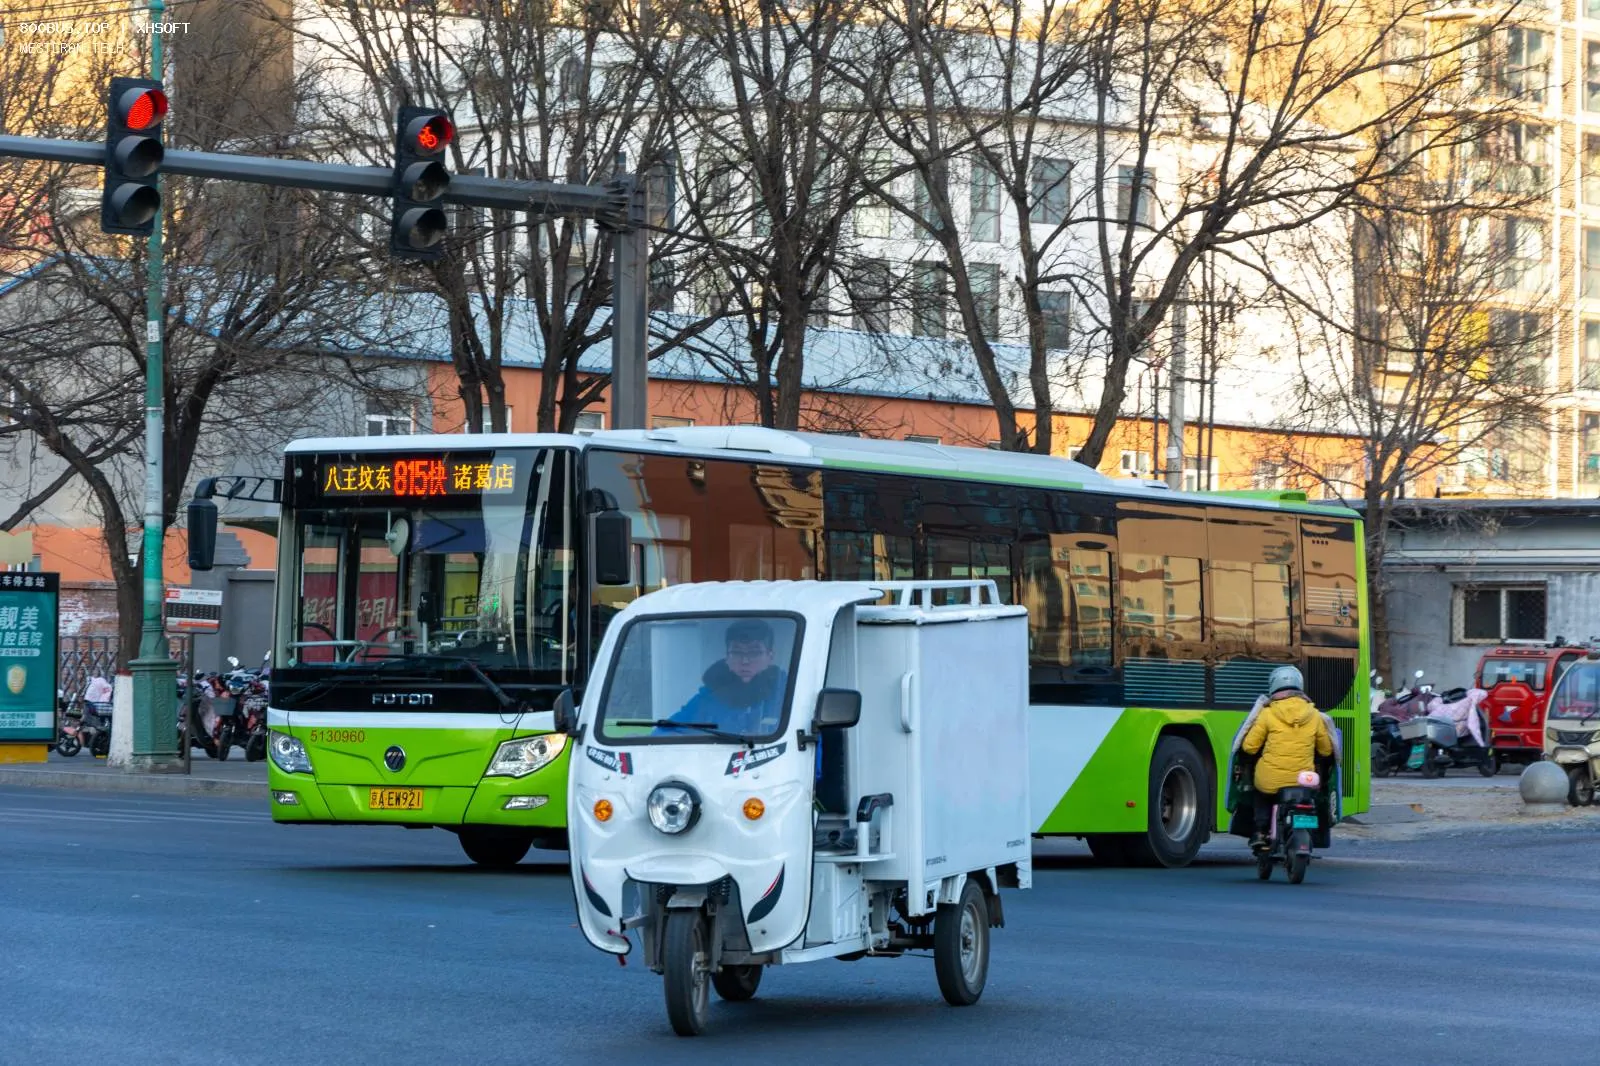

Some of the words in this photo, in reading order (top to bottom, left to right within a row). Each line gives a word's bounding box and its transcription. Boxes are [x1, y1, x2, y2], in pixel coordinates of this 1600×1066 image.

[324, 466, 391, 491] 八王坟东
[394, 460, 448, 496] 815快
[453, 464, 515, 490] 诸葛店
[0, 575, 46, 587] 车停靠站
[0, 632, 43, 646] 腔医院
[371, 693, 433, 705] FOTON
[310, 729, 365, 743] 5130960
